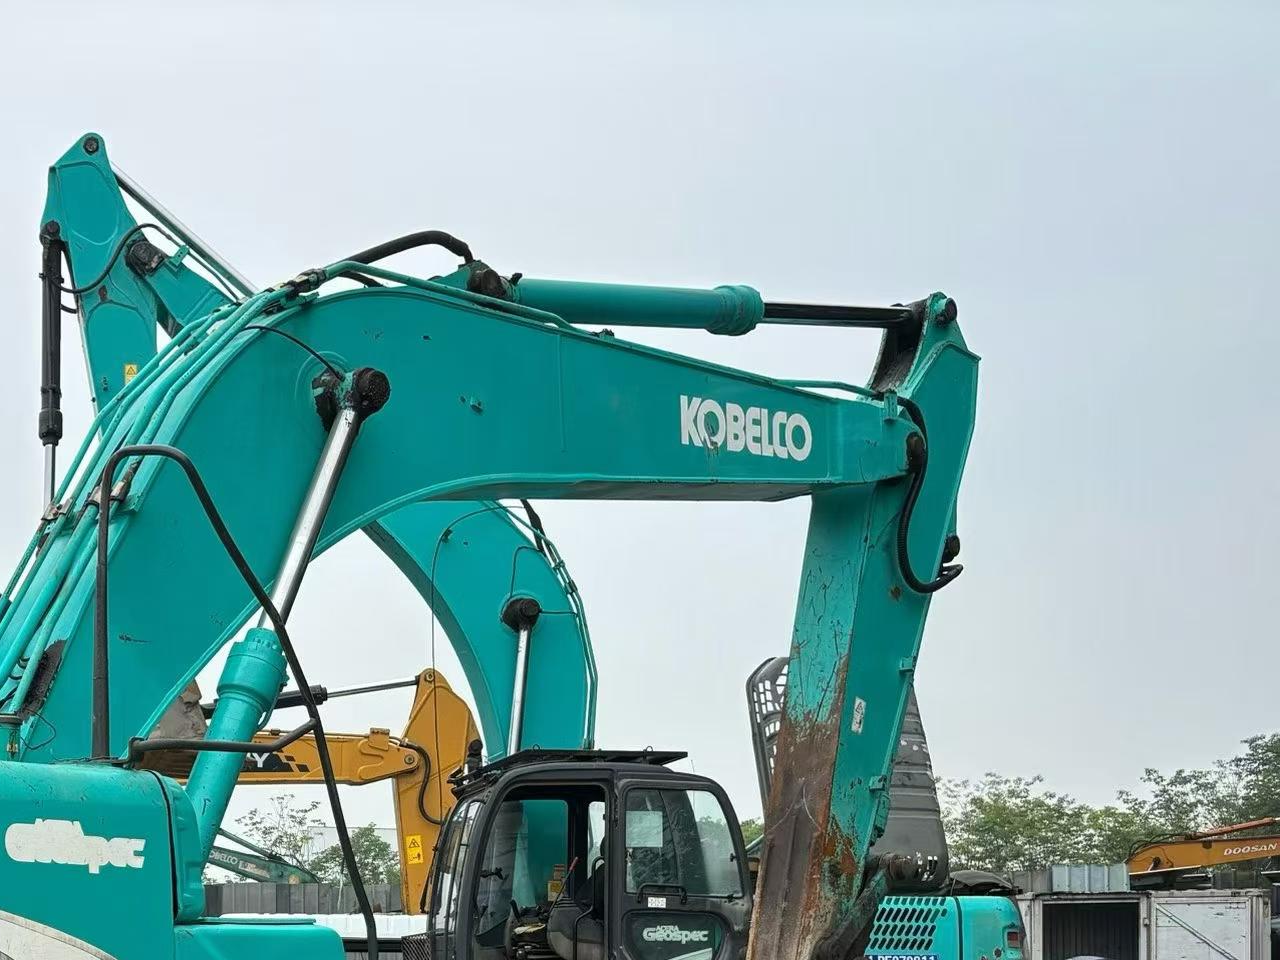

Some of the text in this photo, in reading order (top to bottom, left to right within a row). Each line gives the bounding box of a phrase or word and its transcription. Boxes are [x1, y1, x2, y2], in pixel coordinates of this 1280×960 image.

[680, 395, 812, 461] KOBELCO
[1224, 843, 1278, 856] DOOSAN
[643, 927, 709, 944] Geospec
